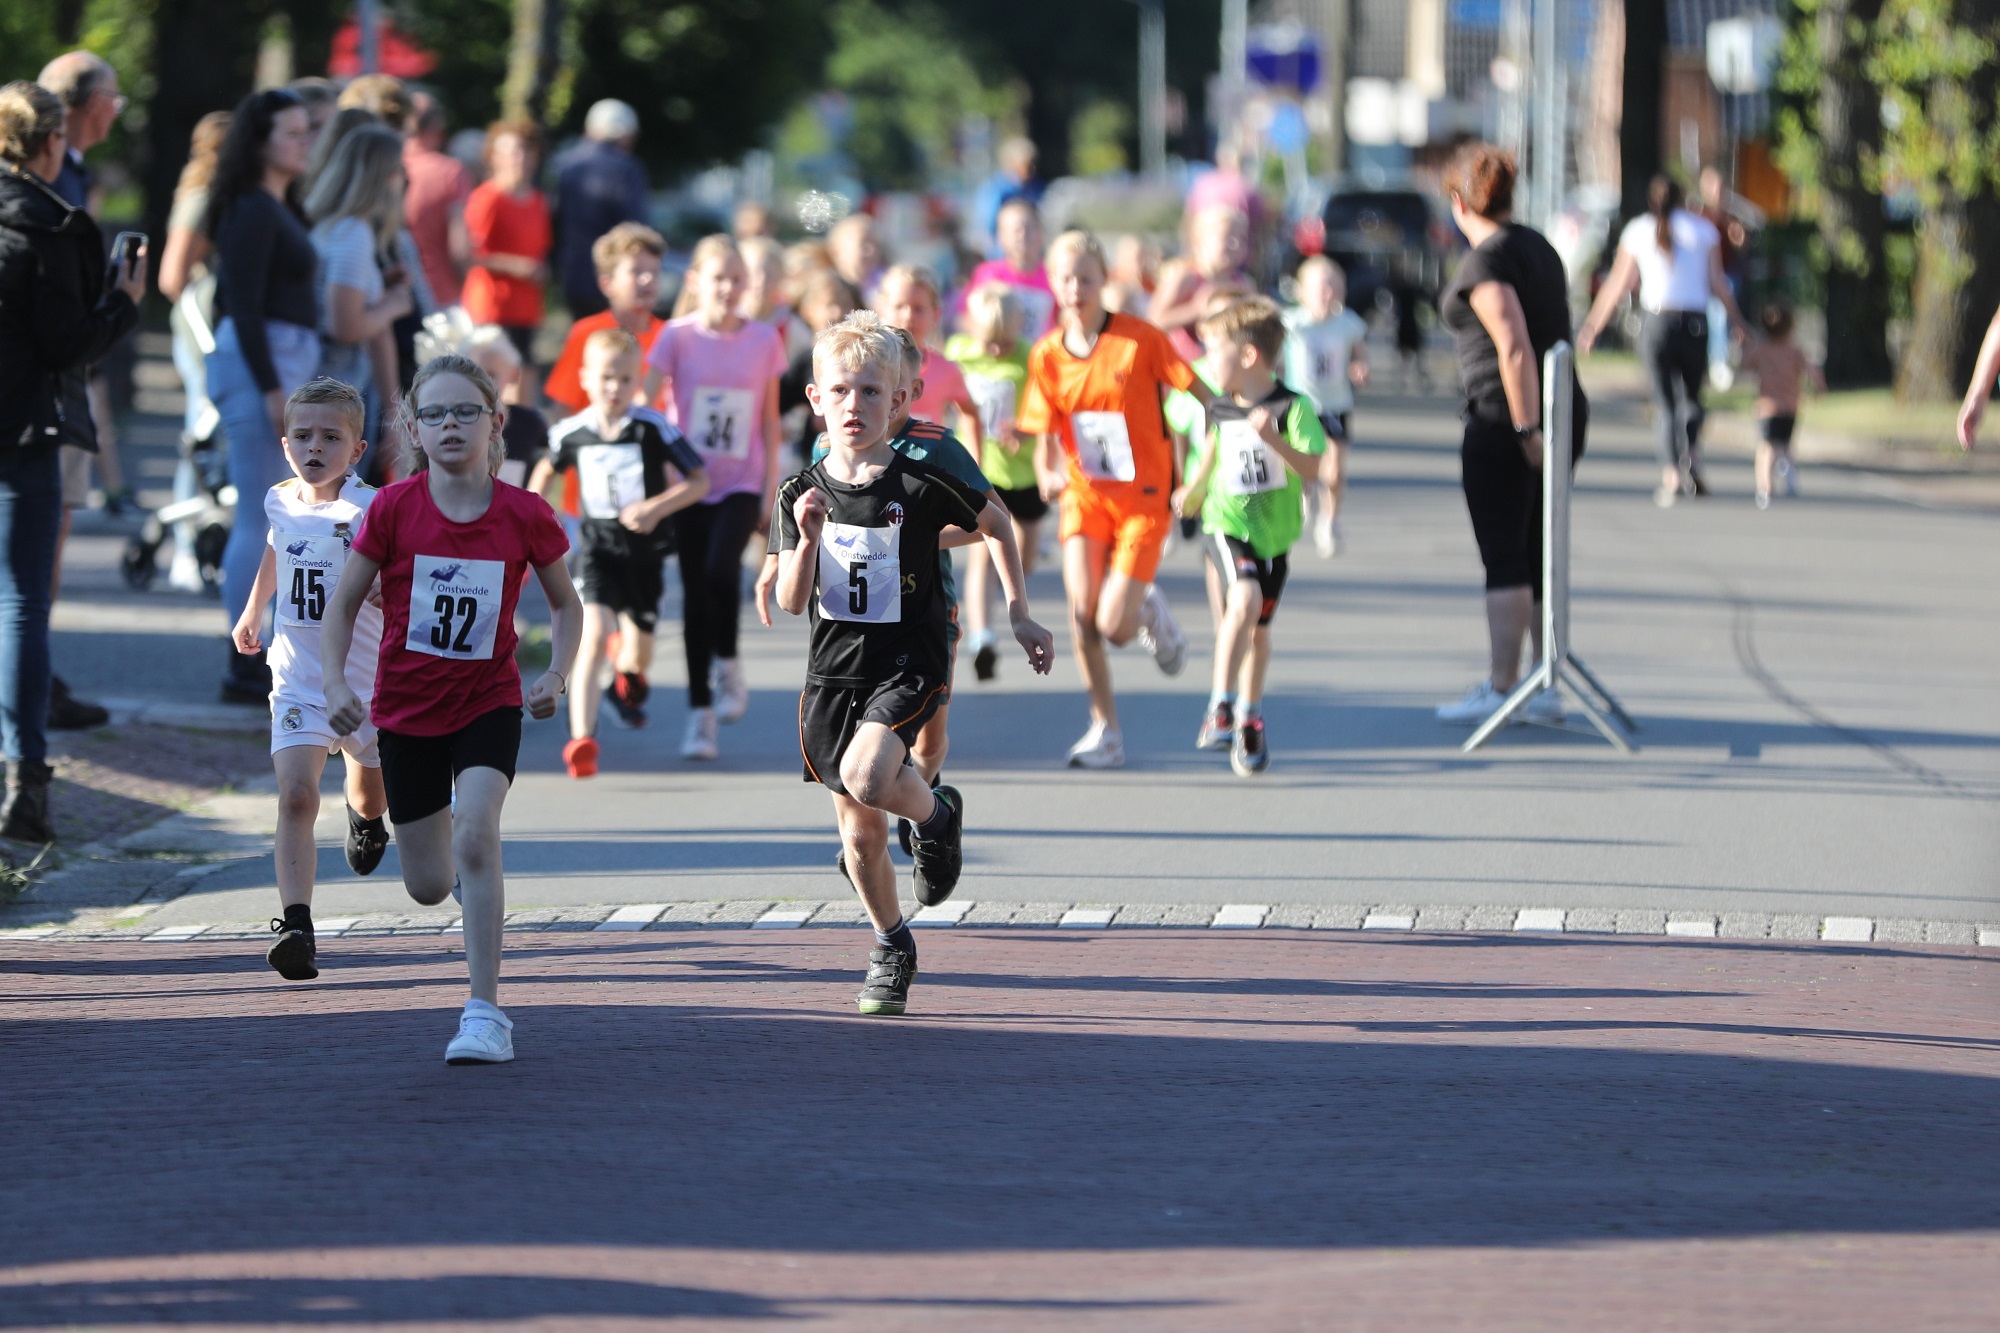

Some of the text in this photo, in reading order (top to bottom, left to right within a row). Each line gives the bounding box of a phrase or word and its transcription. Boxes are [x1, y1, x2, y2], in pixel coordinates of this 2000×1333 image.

[705, 412, 733, 452] 34
[1240, 447, 1268, 485] 35
[292, 557, 333, 568] Onstwedde
[841, 550, 887, 561] Onstwedde
[291, 567, 326, 621] 45
[438, 584, 489, 596] Onstwedde
[849, 561, 868, 615] 5
[431, 594, 478, 653] 32
